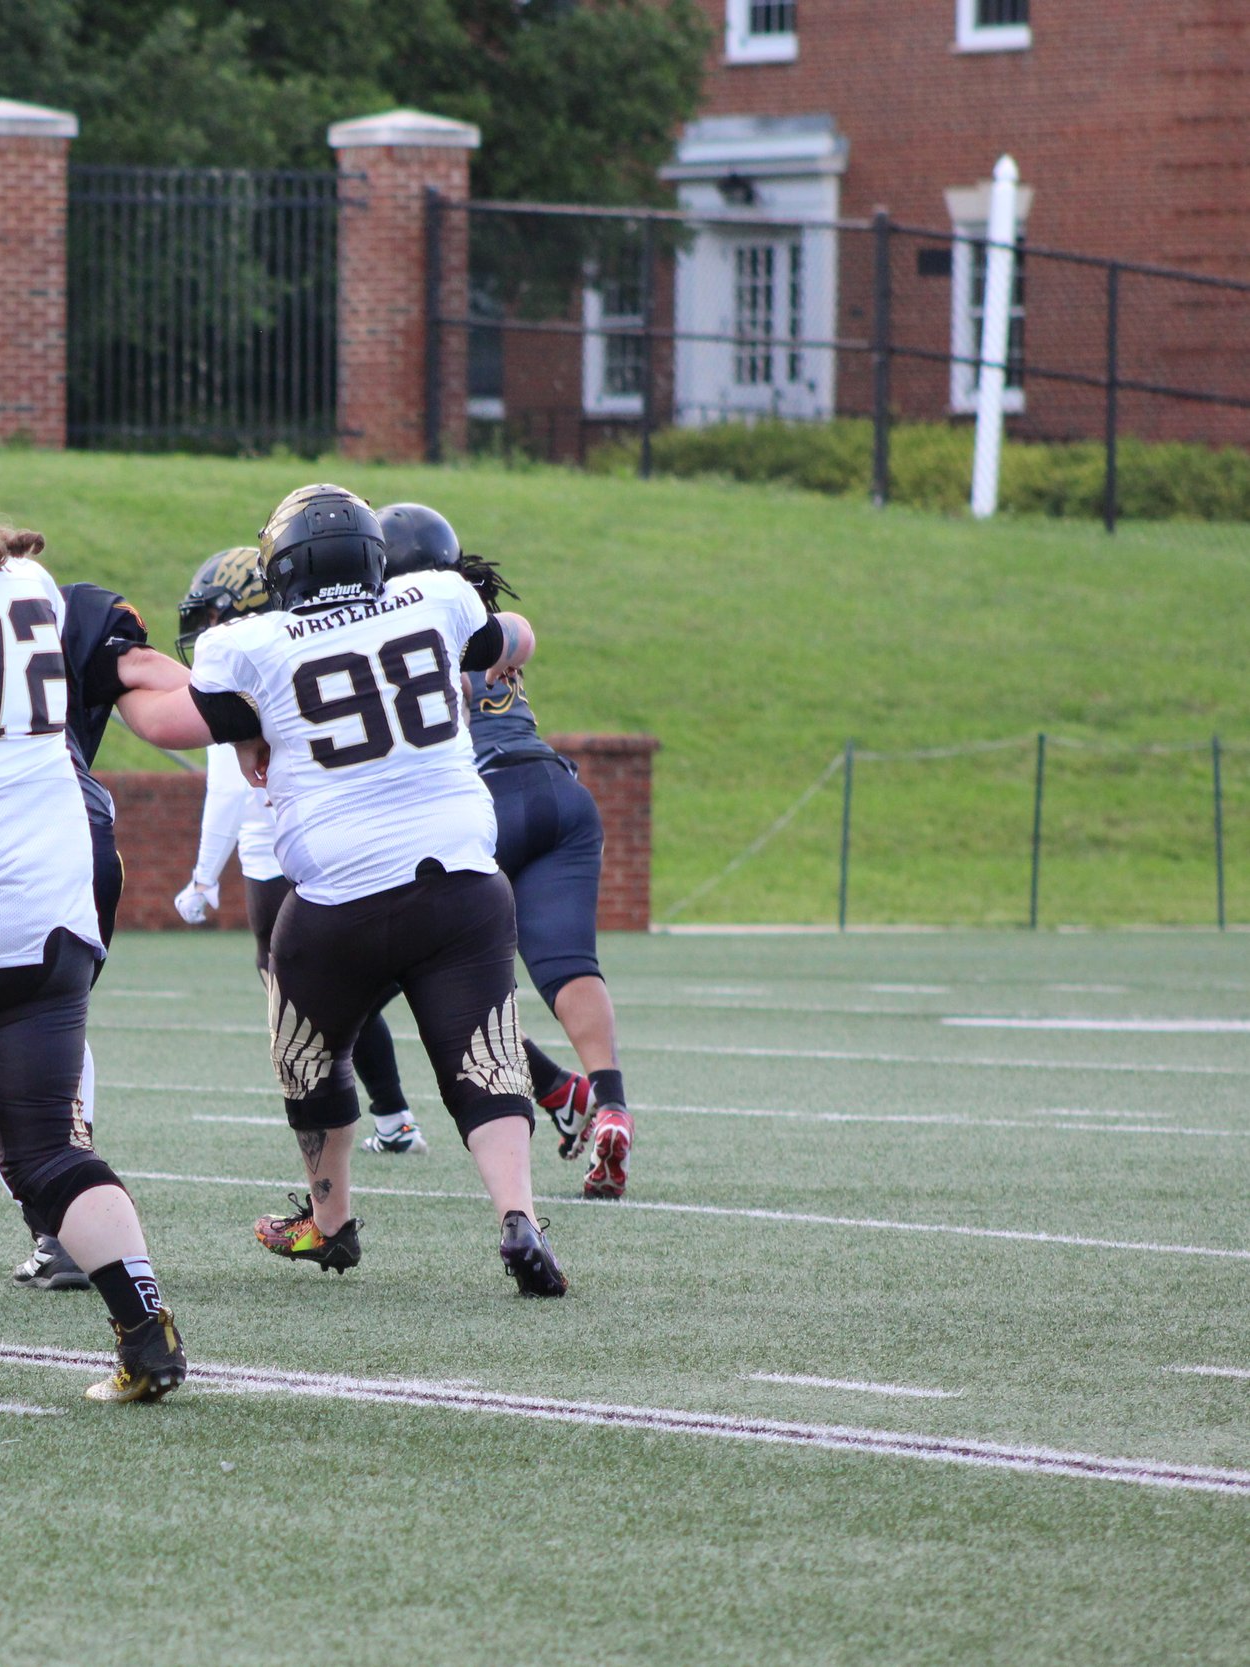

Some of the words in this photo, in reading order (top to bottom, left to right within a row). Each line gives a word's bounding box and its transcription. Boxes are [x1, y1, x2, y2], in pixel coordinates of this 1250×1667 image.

[284, 586, 424, 641] WHITEHEAD
[318, 583, 362, 598] schutt
[291, 628, 459, 771] 98
